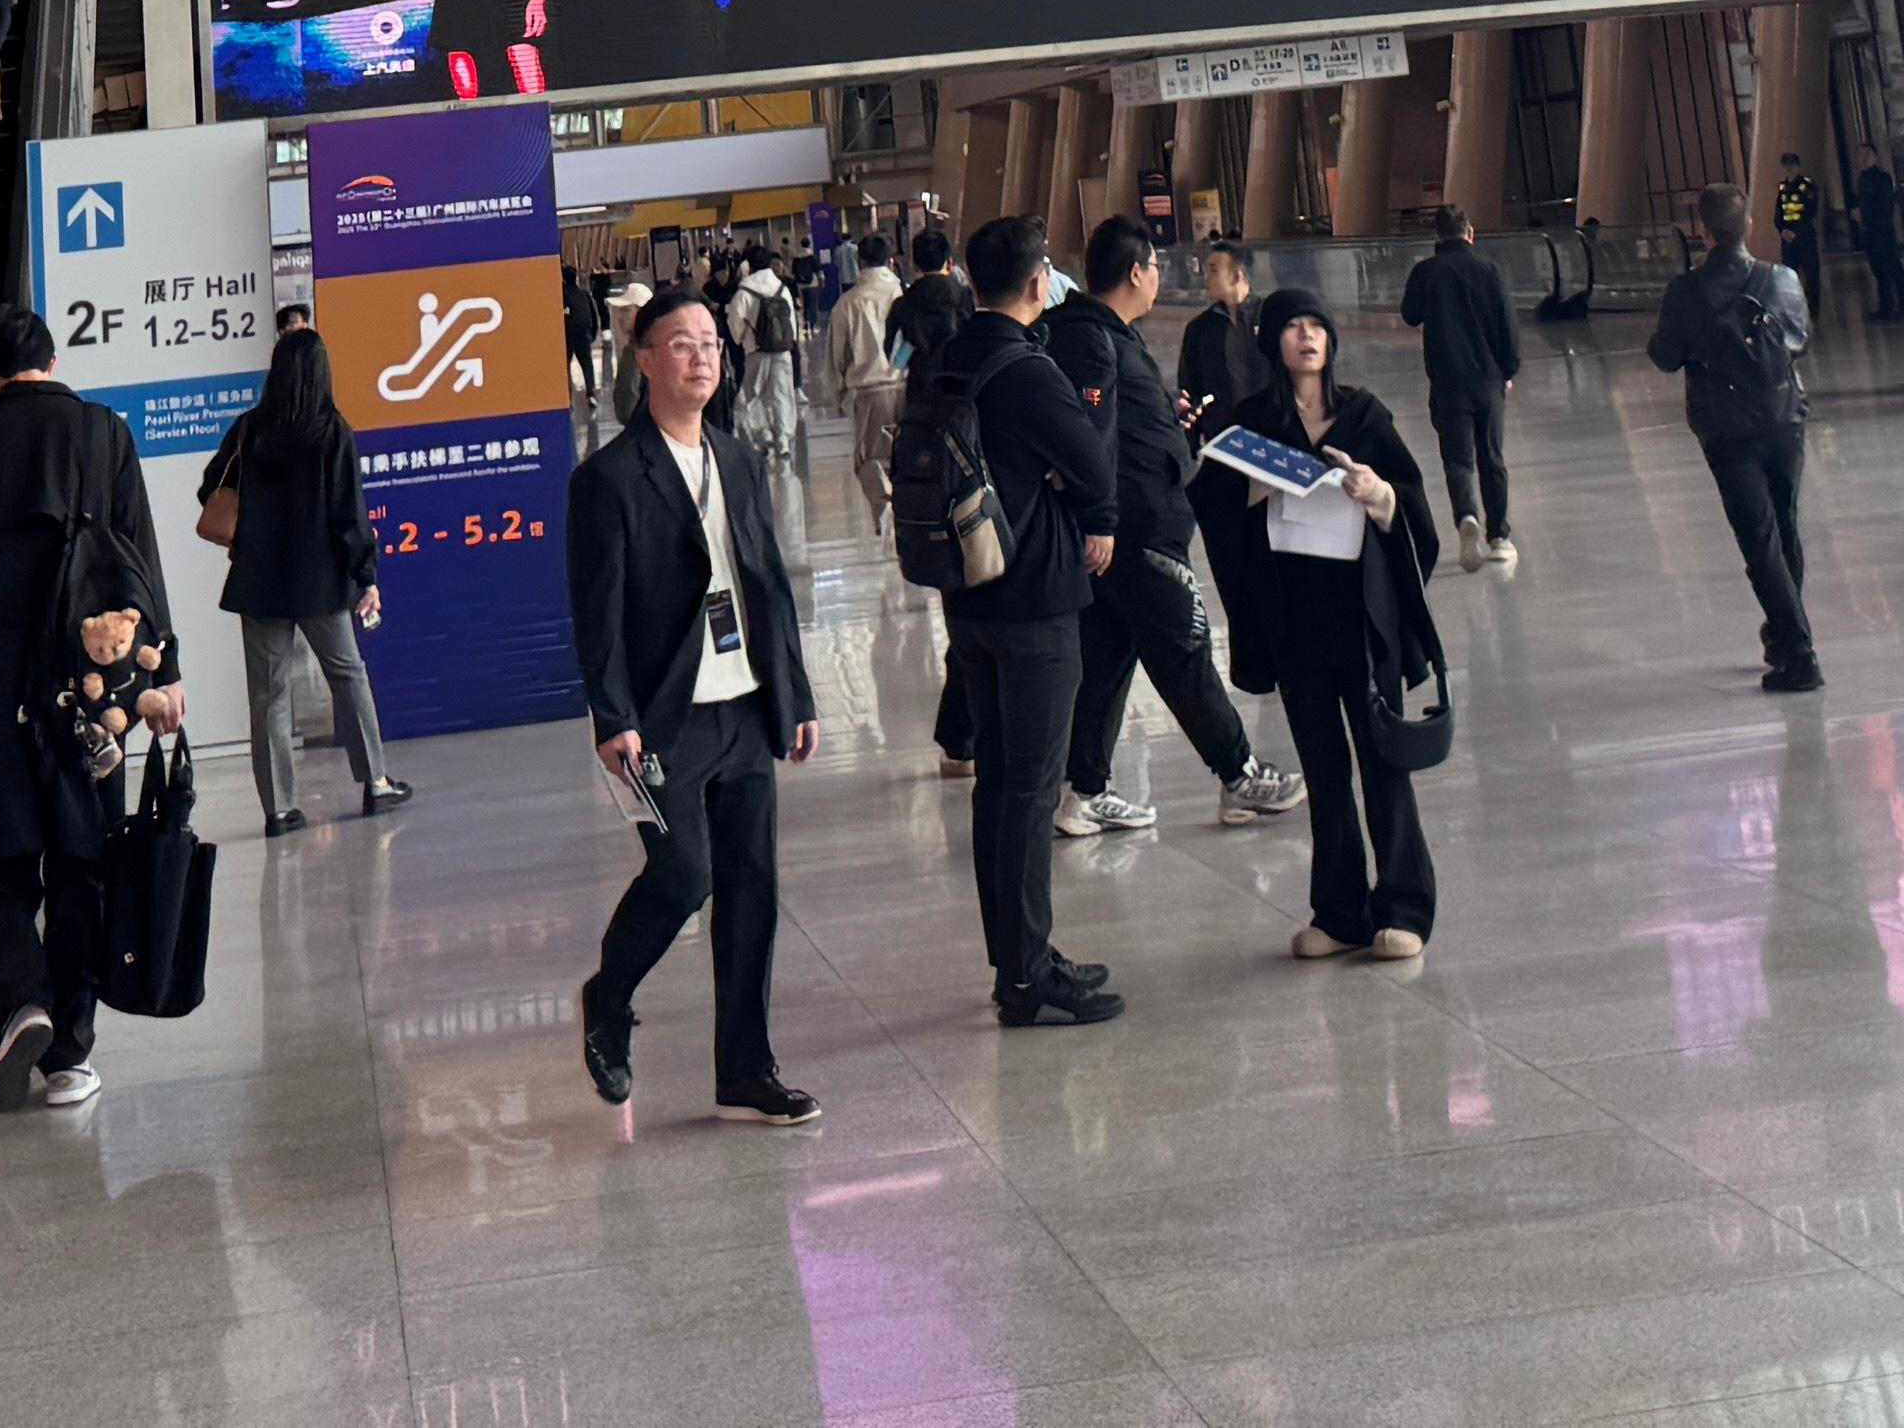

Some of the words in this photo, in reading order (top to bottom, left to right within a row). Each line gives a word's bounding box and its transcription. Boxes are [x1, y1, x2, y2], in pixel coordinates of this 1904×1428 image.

[144, 276, 196, 304] 展厅
[206, 272, 256, 298] Hall
[67, 300, 124, 347] 2F
[144, 308, 256, 348] 1.2-5.2
[145, 413, 172, 426] Pearl
[145, 425, 188, 441] (Service
[189, 423, 220, 436] Floor)
[368, 505, 387, 520] all
[372, 521, 419, 554] .2
[464, 510, 523, 546] 5.2
